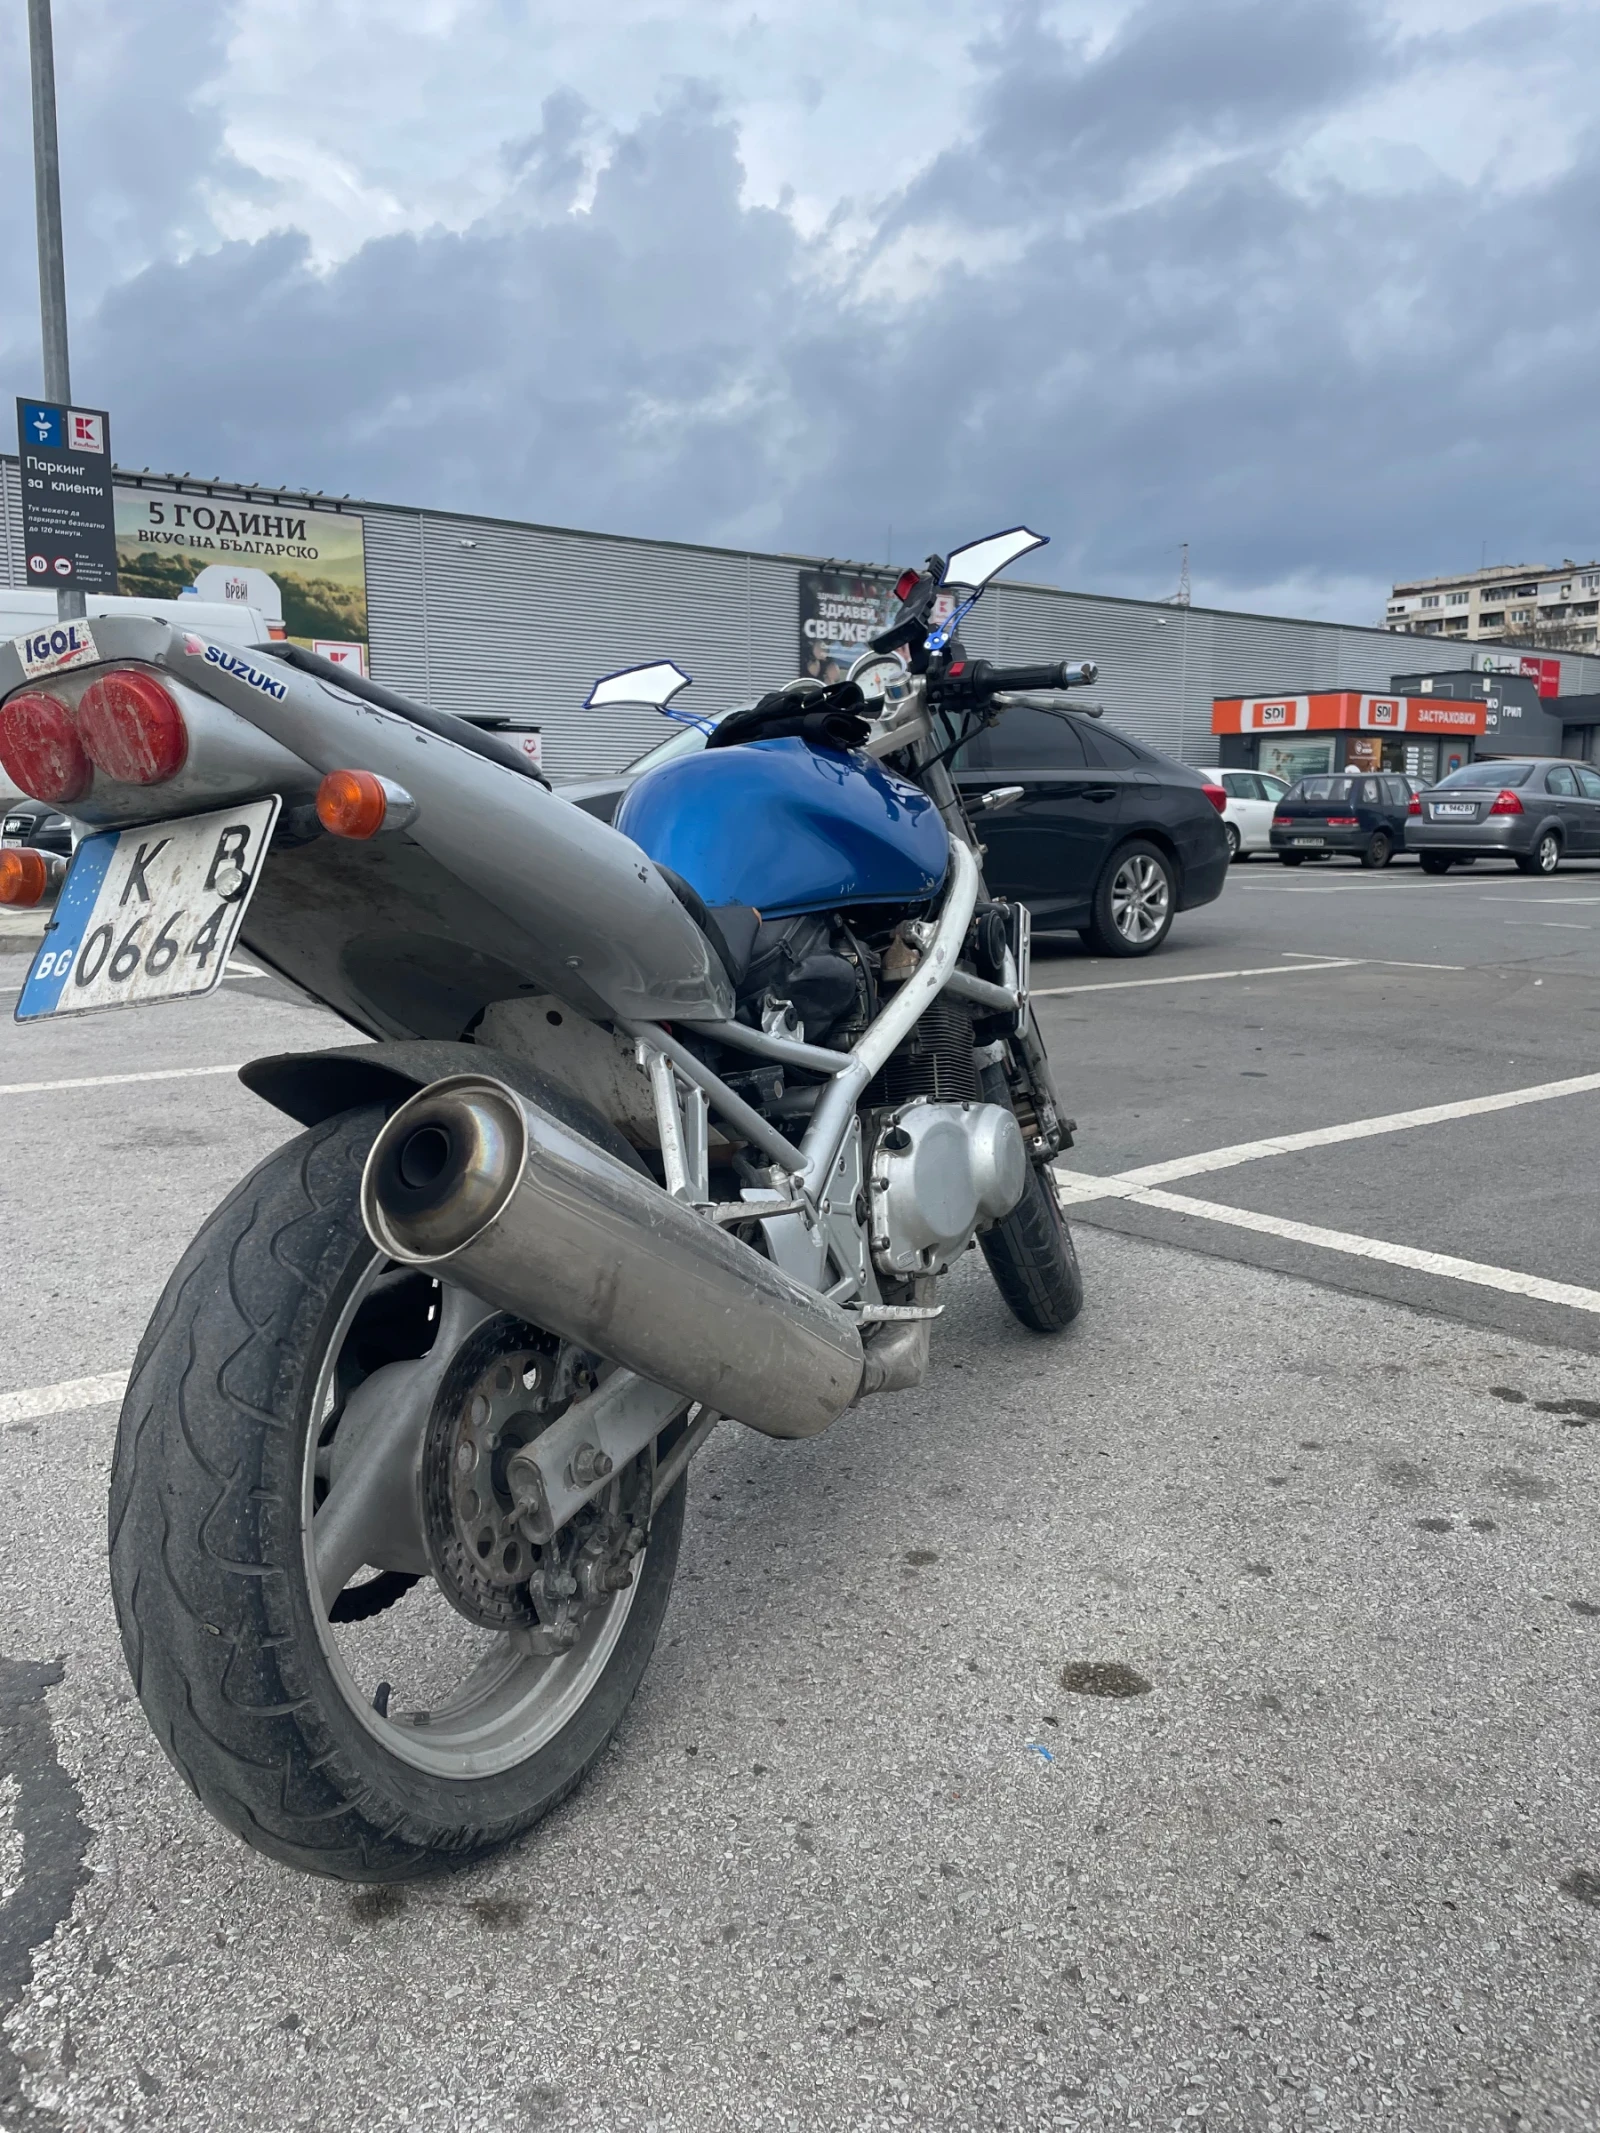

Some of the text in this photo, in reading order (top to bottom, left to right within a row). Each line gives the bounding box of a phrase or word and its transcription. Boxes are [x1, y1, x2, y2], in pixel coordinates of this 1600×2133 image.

[39, 430, 48, 442] P
[26, 456, 86, 476] Паркинг
[27, 478, 103, 496] за клиенти
[28, 504, 40, 512] Тук
[41, 507, 69, 515] можете
[28, 516, 105, 530] паркирате безплатно
[149, 501, 307, 541] 5 ГОДИНИ
[40, 526, 53, 534] 120
[137, 529, 319, 560] ВКУС НА БЪЛГАРСКО
[34, 559, 44, 569] 10
[818, 603, 878, 623] ЗДРАВЕЙ,
[204, 646, 287, 700] SUZUKI
[1264, 707, 1285, 720] SDI
[1376, 705, 1391, 718] SDI
[1417, 709, 1476, 725] ЗАСТРАХОВКИ
[1502, 705, 1522, 718] ГРИЛ
[119, 837, 174, 907] K
[75, 902, 229, 988] 0664
[34, 949, 73, 980] BG
